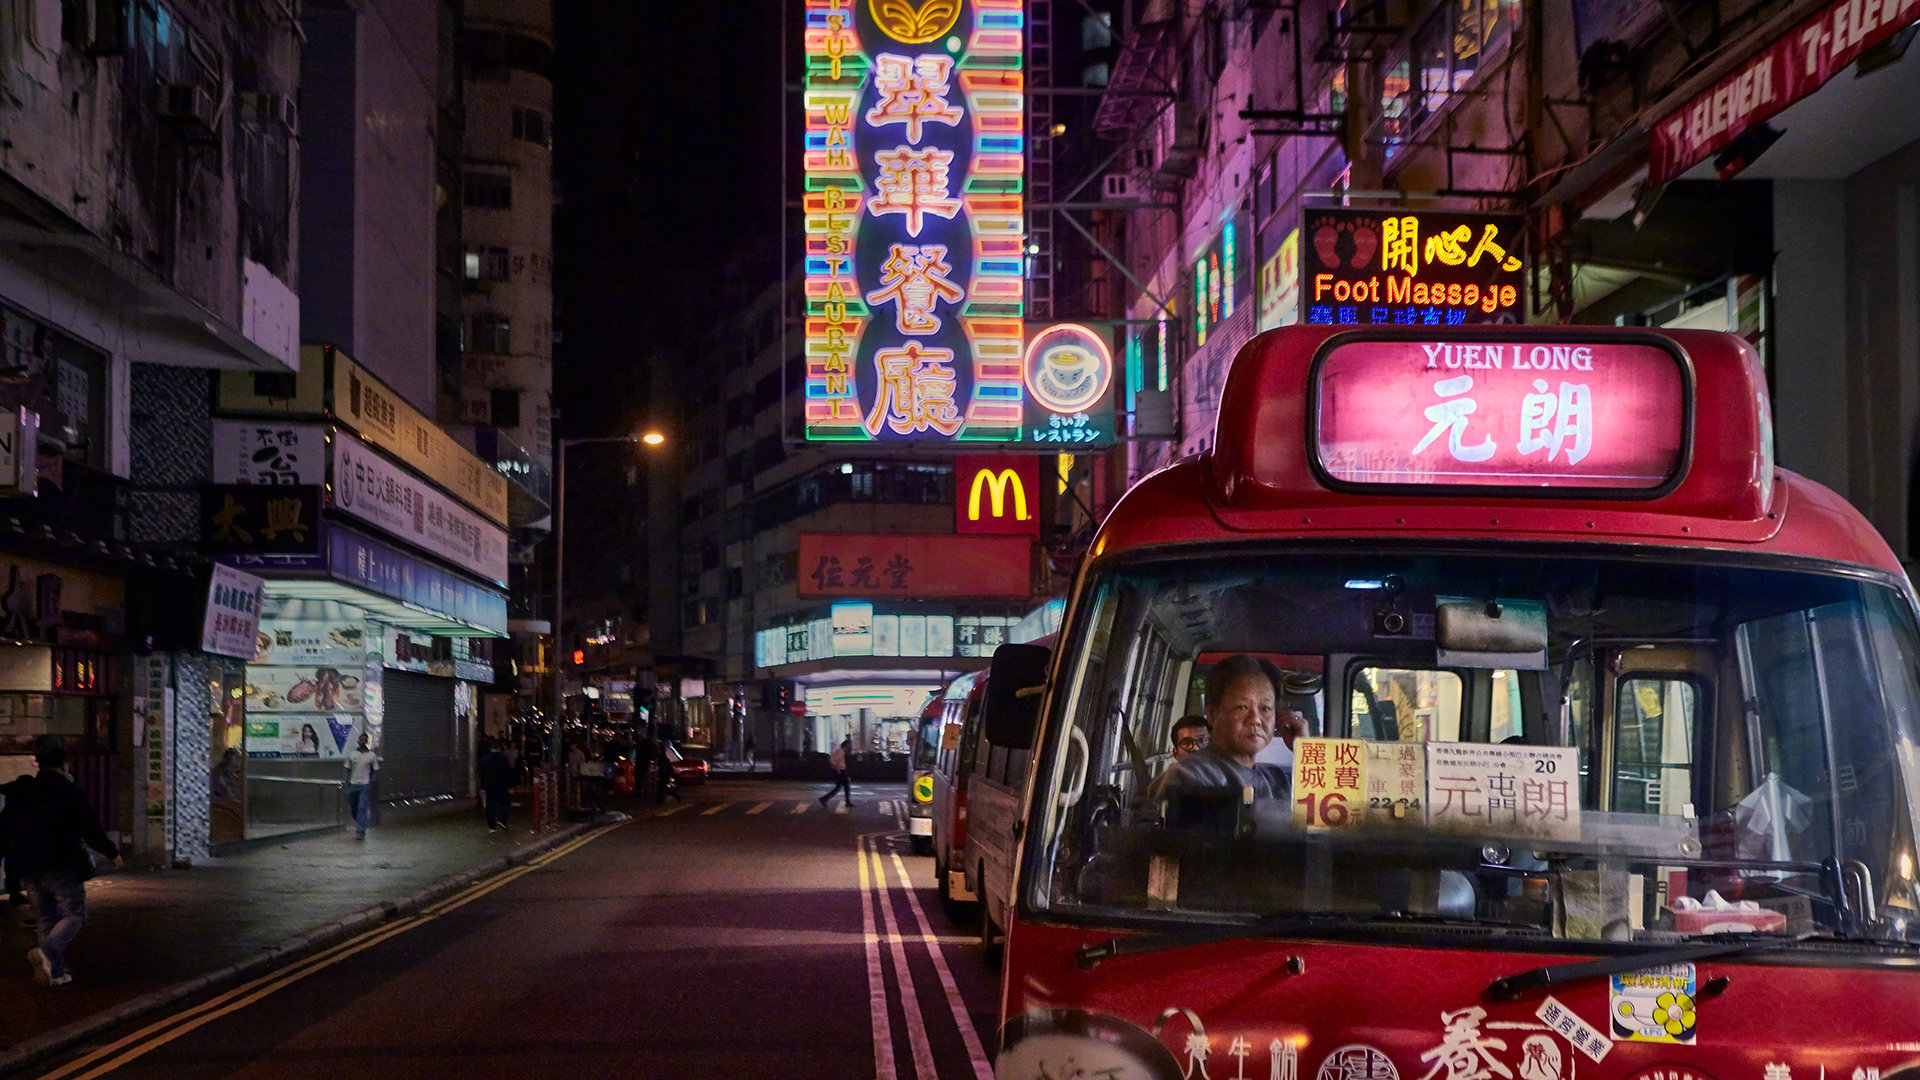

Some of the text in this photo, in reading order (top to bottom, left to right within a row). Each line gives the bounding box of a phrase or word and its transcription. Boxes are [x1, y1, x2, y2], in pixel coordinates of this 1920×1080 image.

[826, 0, 847, 80] SUI
[824, 103, 848, 166] WAH
[866, 53, 965, 437] 翠華餐廳
[1382, 216, 1523, 277] 開心人
[824, 185, 848, 417] RESTAURANT
[1315, 273, 1380, 303] Foot
[1387, 276, 1517, 313] Massage
[1421, 343, 1593, 371] YUEN LONG
[1032, 428, 1100, 443] レストラン
[1412, 376, 1593, 465] 元朗
[1300, 742, 1327, 789] 麗城
[1335, 743, 1360, 790] 收費
[1535, 760, 1556, 774] 20
[1644, 1028, 1662, 1036] LPG
